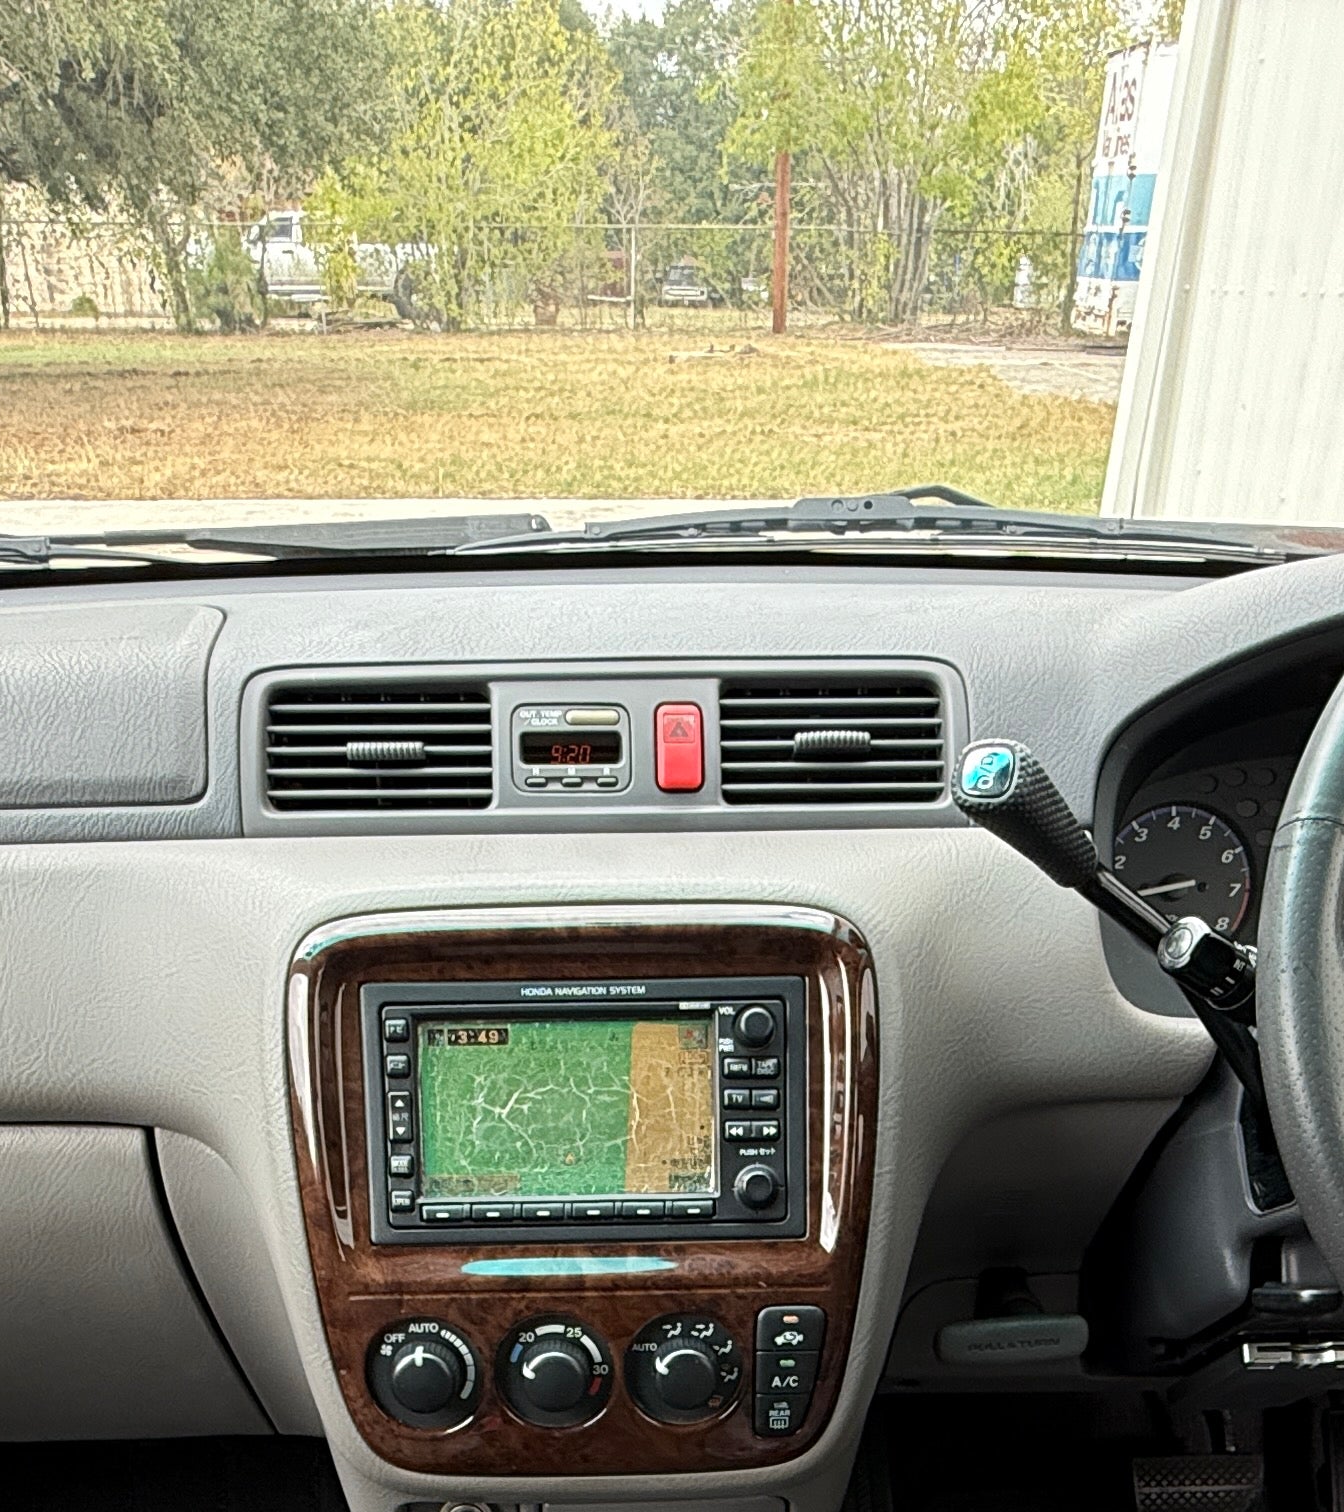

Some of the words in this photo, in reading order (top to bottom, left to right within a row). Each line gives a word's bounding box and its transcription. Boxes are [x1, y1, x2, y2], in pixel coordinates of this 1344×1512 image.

[541, 710, 562, 718] TEMP
[551, 745, 591, 764] 9:20
[1167, 816, 1181, 831] 4
[1134, 827, 1149, 843] 3
[1198, 825, 1213, 841] 5
[1114, 854, 1127, 870] 2
[1221, 849, 1235, 864] 6
[1228, 882, 1242, 898] 7
[1214, 916, 1231, 931] 8
[520, 987, 553, 997] HONDA
[555, 986, 607, 996] NAVIGATION
[609, 985, 646, 995] SYSTEM
[718, 1006, 736, 1016] VOL
[731, 1094, 743, 1103] TV
[739, 1148, 758, 1156] PUSH
[408, 1323, 439, 1333] AUTO
[566, 1327, 582, 1338] 25
[384, 1333, 405, 1343] OFF
[519, 1332, 535, 1343] 20
[632, 1343, 658, 1351] AUTO
[593, 1364, 609, 1375] 30
[771, 1376, 799, 1388] A/C
[769, 1409, 791, 1417] REAR
